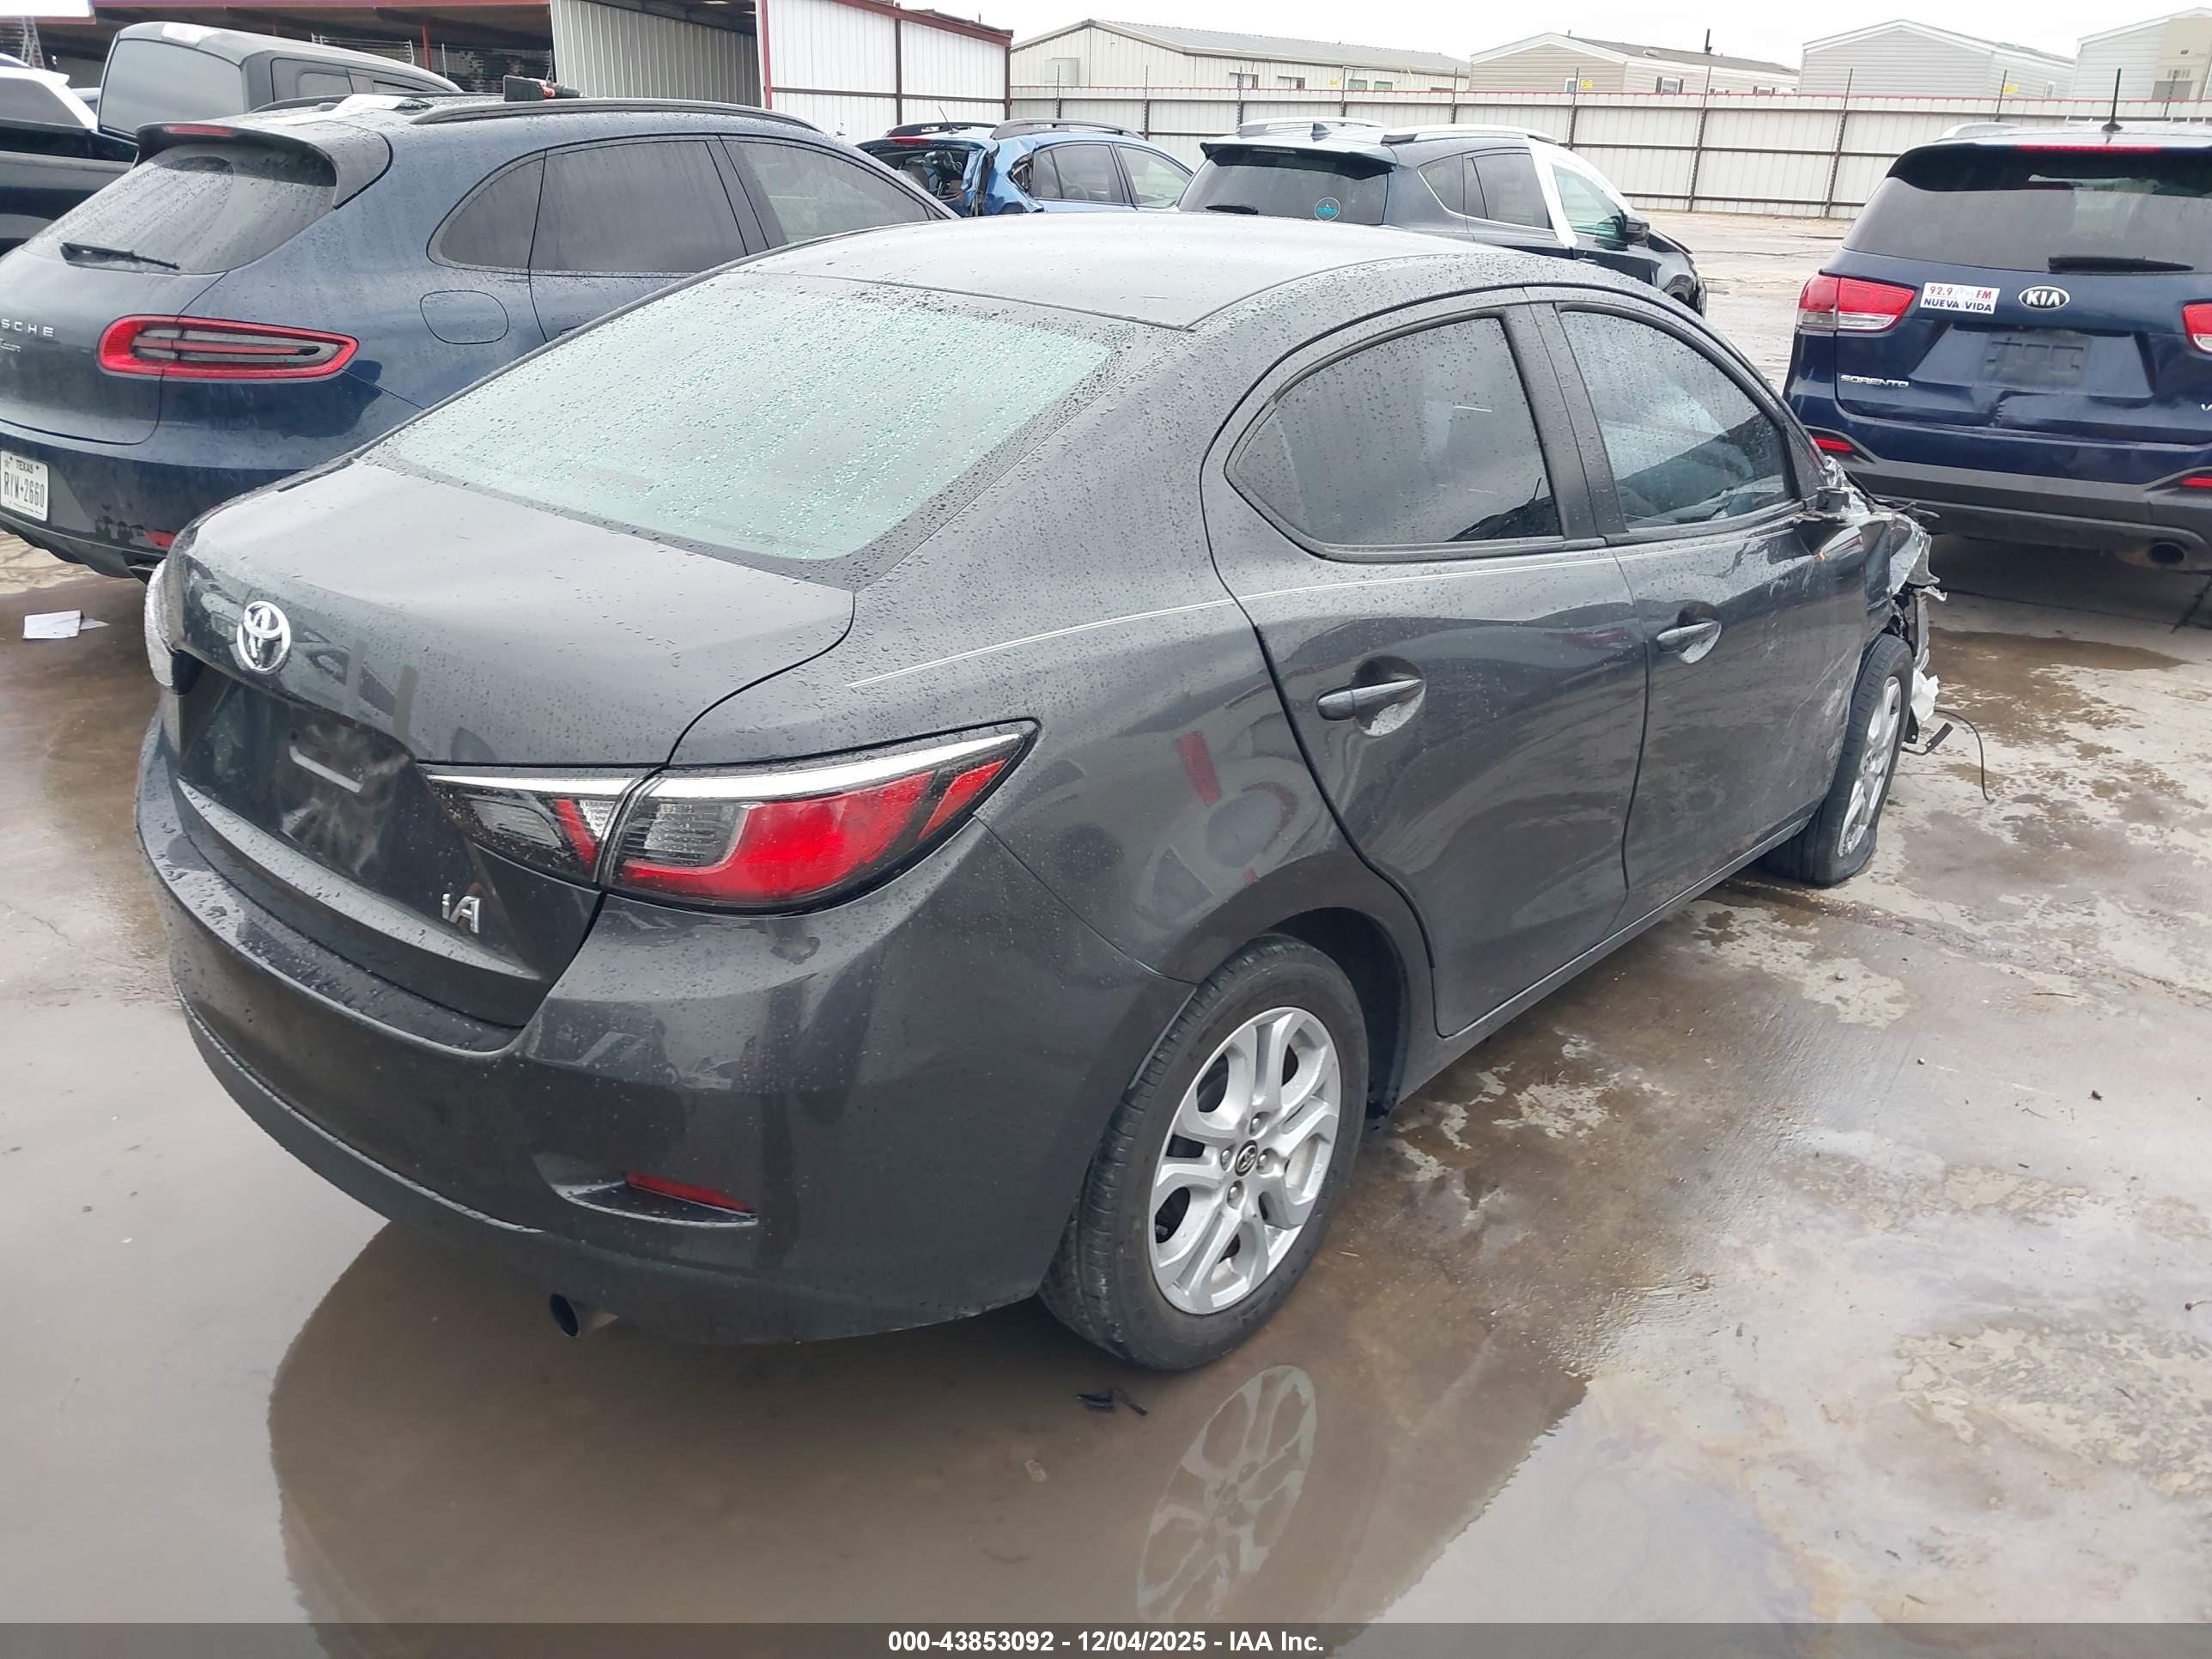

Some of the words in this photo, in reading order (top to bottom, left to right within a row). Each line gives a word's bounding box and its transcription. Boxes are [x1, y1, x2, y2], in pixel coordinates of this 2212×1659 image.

[1929, 285, 1953, 296] 92.9
[1976, 290, 1992, 300] FM
[2026, 290, 2061, 307] KIA
[1923, 298, 1960, 309] NUEVA
[1965, 301, 1992, 312] VIDA
[1, 318, 55, 337] SCHE
[1840, 374, 1910, 388] SORENTO
[15, 459, 33, 474] TEXAS
